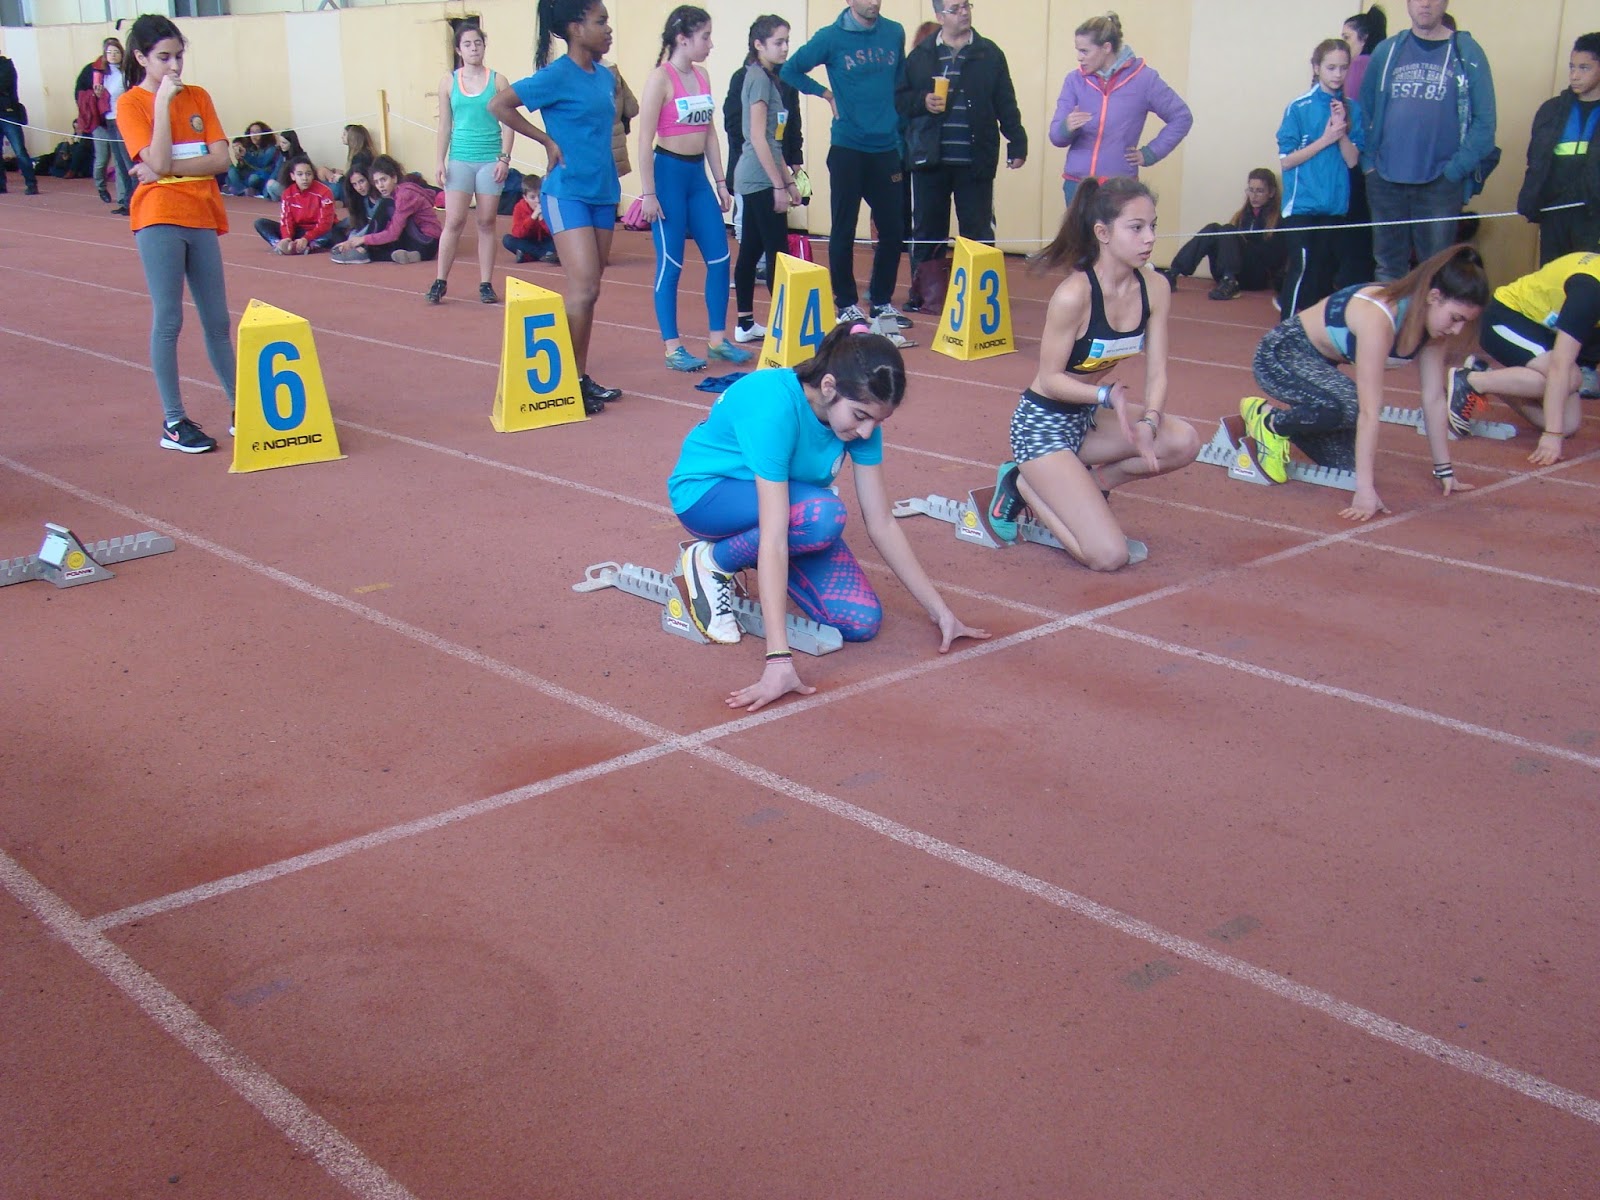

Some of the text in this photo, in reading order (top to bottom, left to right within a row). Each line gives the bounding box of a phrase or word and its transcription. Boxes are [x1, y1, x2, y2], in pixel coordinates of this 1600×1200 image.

[687, 108, 713, 123] 1008
[772, 284, 784, 353] 4
[799, 287, 826, 355] 4
[950, 267, 966, 332] 3
[979, 269, 1001, 335] 3
[524, 313, 562, 395] 5
[979, 338, 1007, 350] NORDIC
[257, 340, 307, 431] 6
[528, 396, 576, 412] NORDIC
[262, 433, 323, 451] NORDIC
